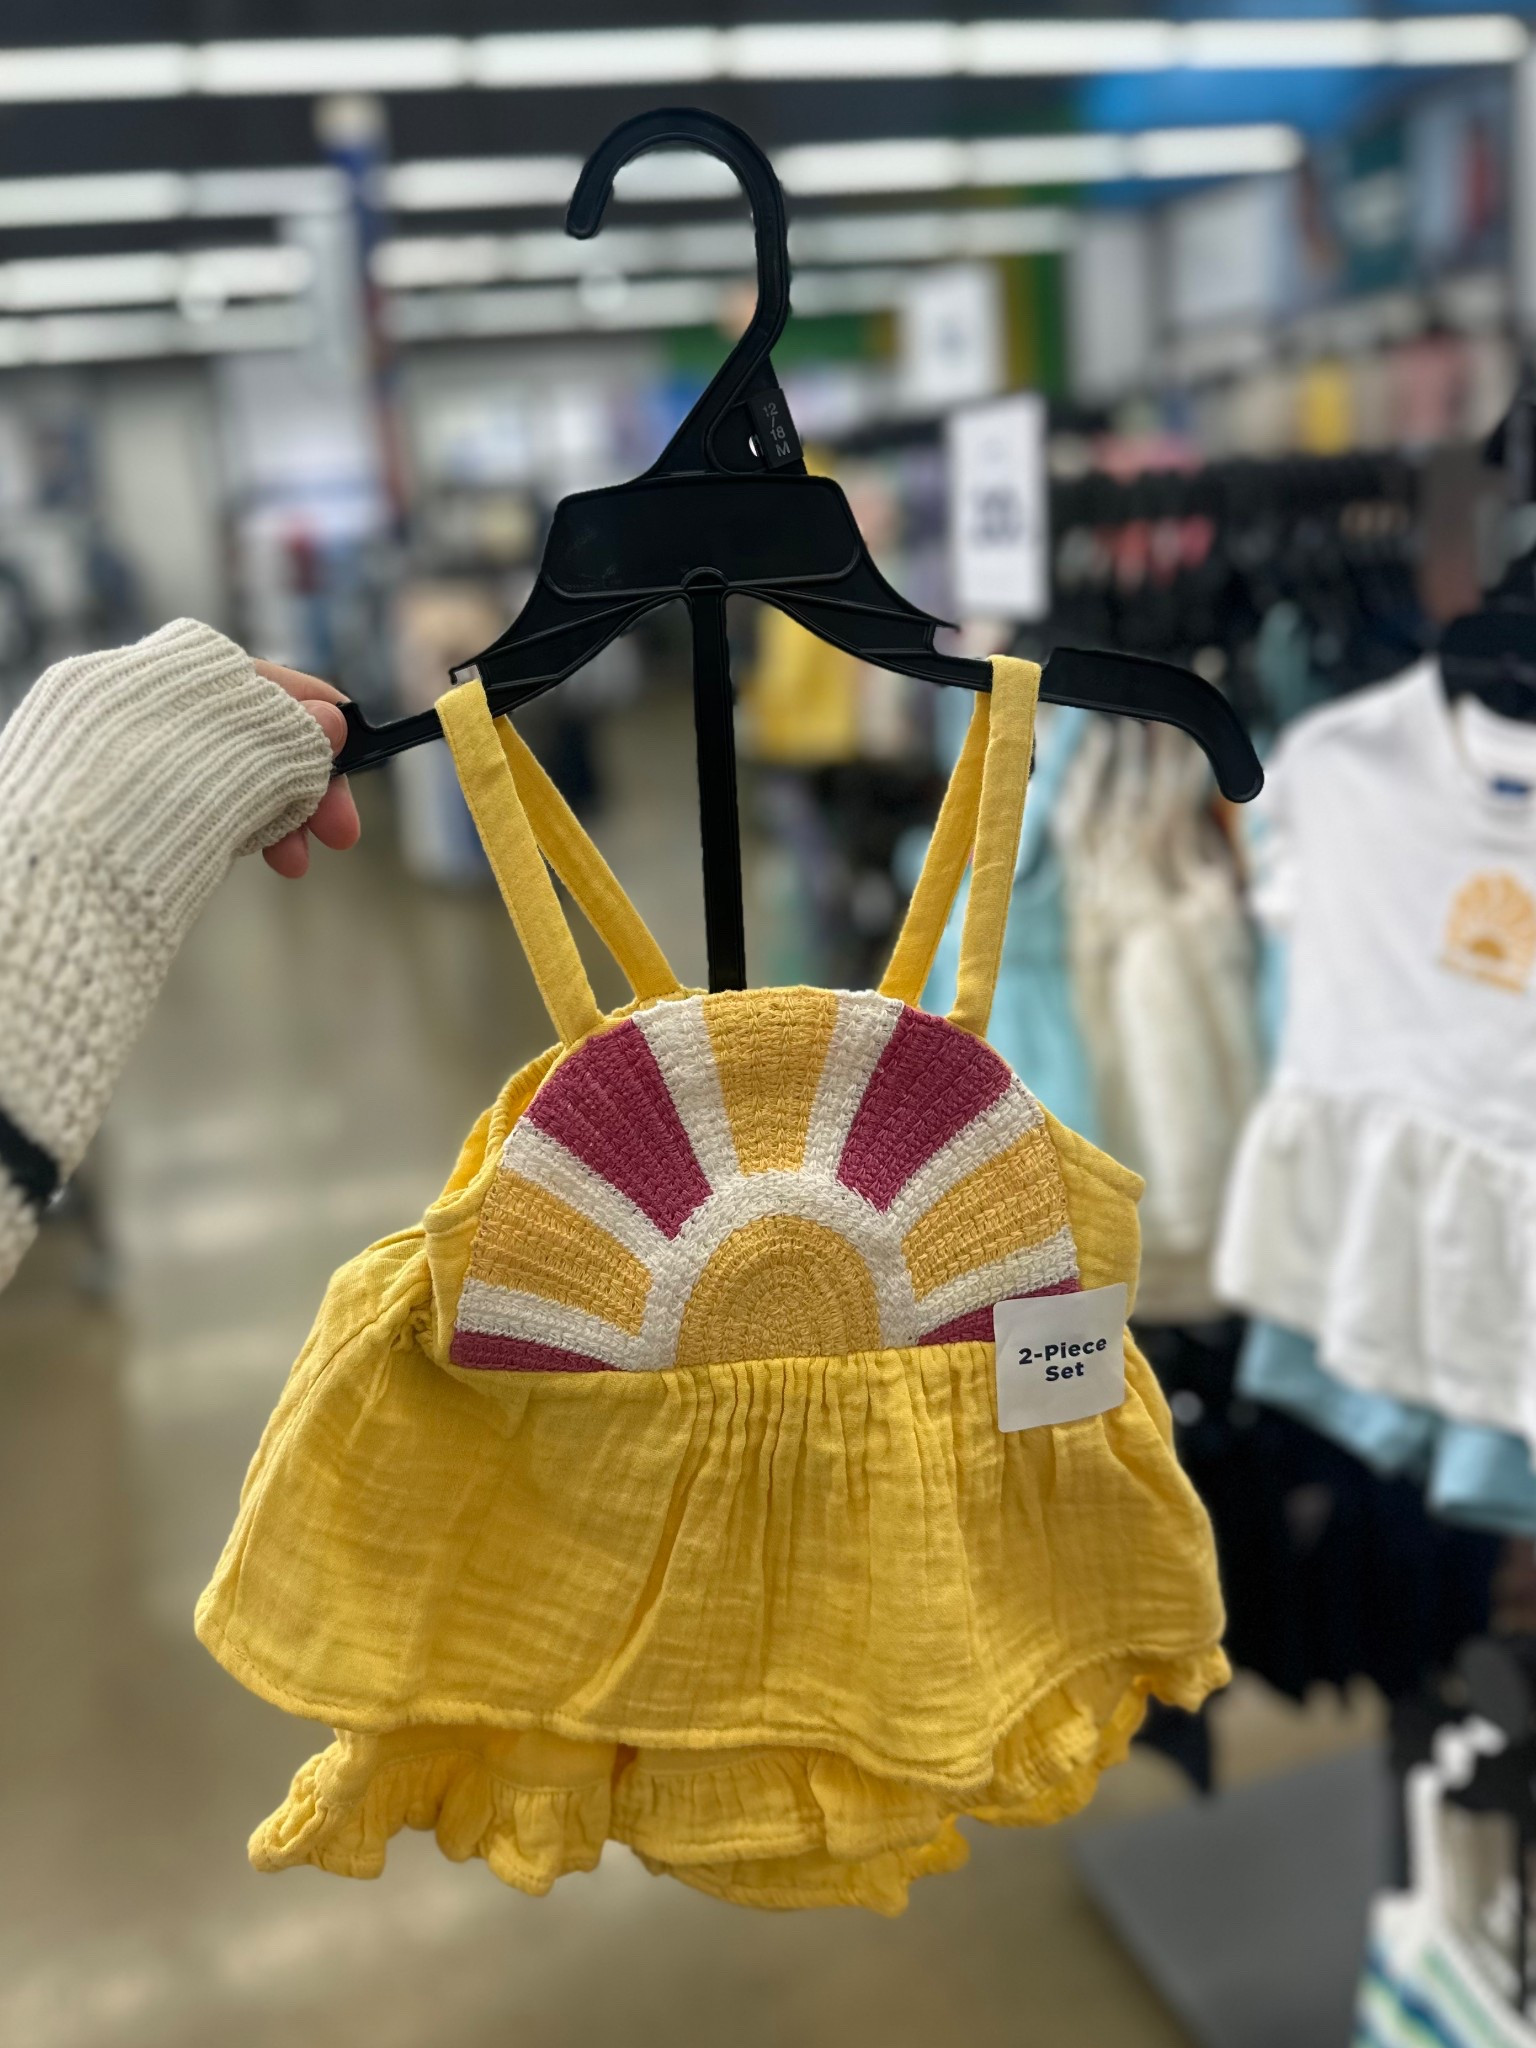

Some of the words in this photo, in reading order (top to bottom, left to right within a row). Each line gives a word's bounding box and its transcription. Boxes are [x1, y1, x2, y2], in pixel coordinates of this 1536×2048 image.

[763, 402, 778, 417] 12
[770, 426, 785, 440] 18
[776, 441, 790, 456] M
[1018, 1338, 1107, 1365] 2-Piece
[1045, 1362, 1084, 1382] Set
